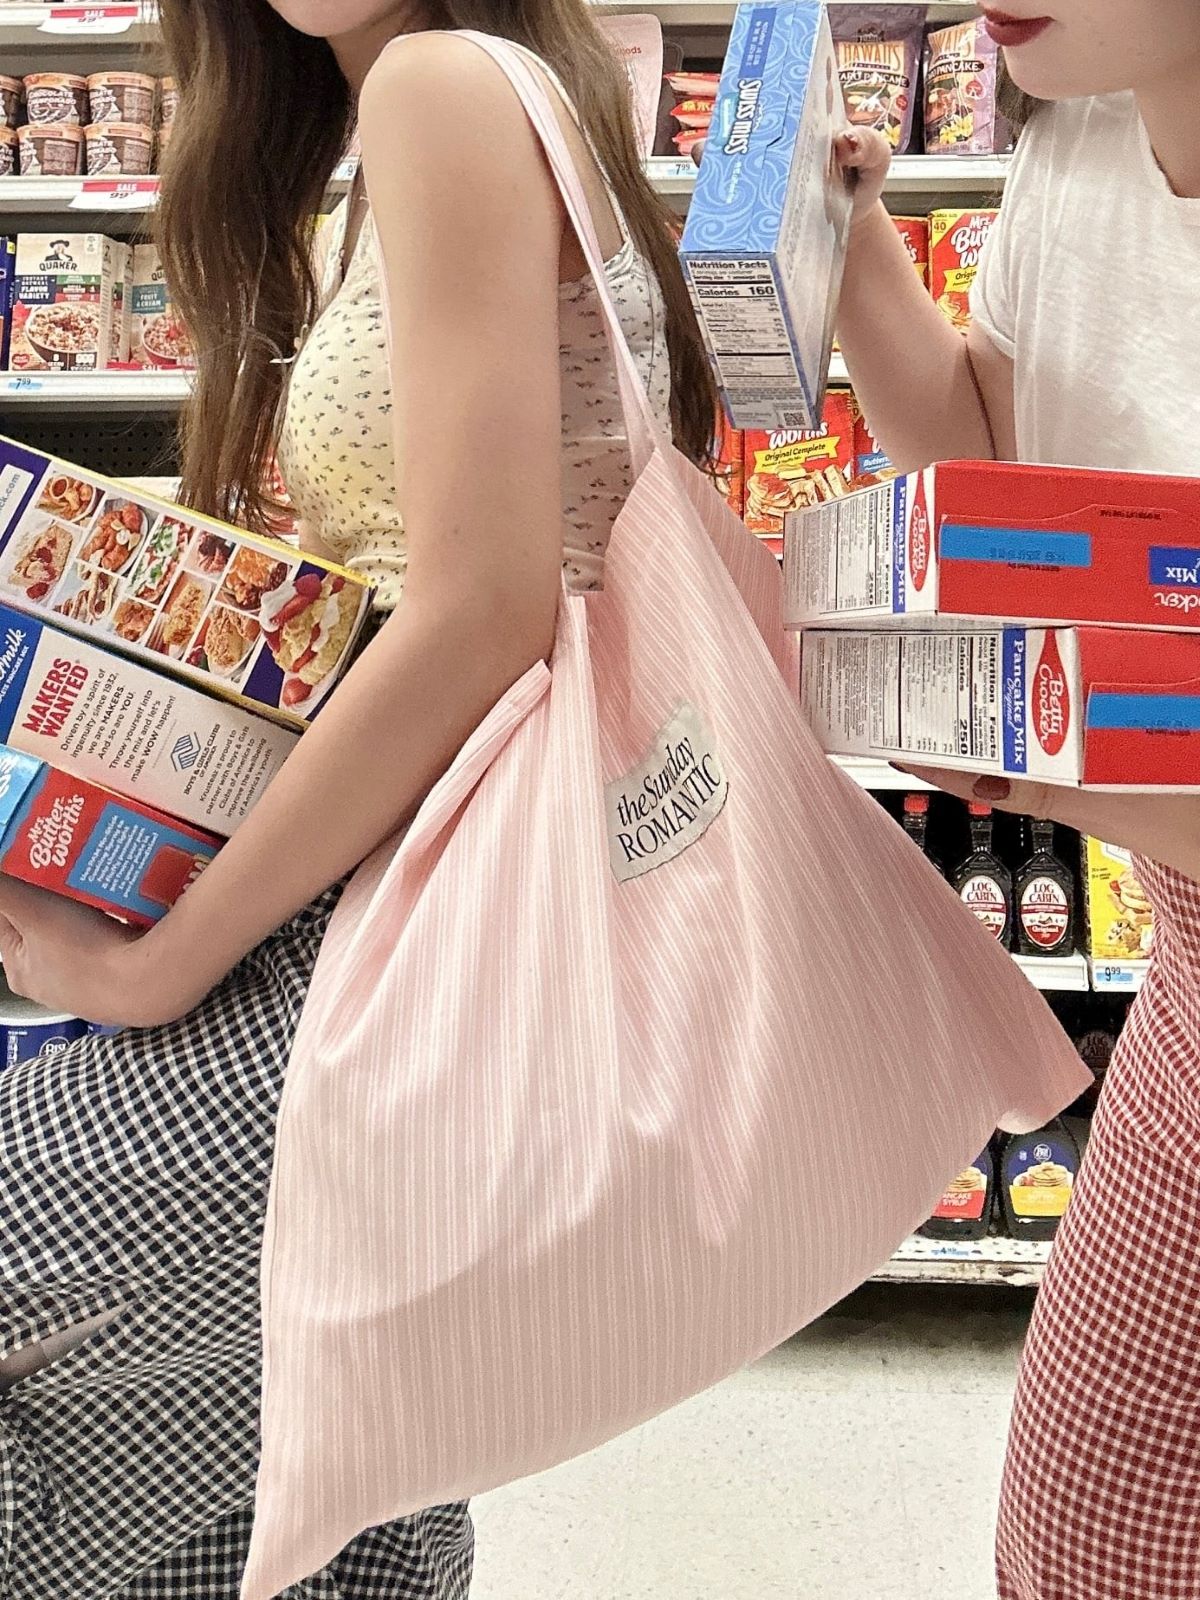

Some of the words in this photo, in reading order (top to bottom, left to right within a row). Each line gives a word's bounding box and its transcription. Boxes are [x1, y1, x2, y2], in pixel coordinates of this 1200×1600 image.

[736, 79, 763, 121] SWISS
[724, 120, 753, 156] MISS
[117, 183, 137, 191] SALE
[934, 222, 946, 230] 40
[39, 262, 78, 272] QUAKER
[690, 261, 735, 269] Nutrition
[738, 261, 767, 269] Facts
[749, 286, 774, 295] 160
[764, 449, 792, 461] Original
[793, 443, 826, 454] Complete
[898, 486, 907, 574] Pancake
[911, 504, 921, 584] Crocker
[917, 509, 927, 572] Betty
[897, 574, 906, 606] Mix
[1166, 566, 1197, 584] Mix
[1154, 592, 1200, 613] cker
[22, 658, 73, 733] MAKERS
[40, 664, 90, 738] WANTED
[1006, 677, 1017, 731] Original
[1013, 640, 1025, 723] Pancake
[1050, 672, 1064, 736] Betty
[60, 723, 79, 750] Driven
[75, 710, 86, 721] by
[86, 679, 100, 701] spirit
[98, 668, 105, 678] of
[70, 718, 95, 757] ingenuity
[92, 694, 106, 716] since
[1039, 663, 1053, 748] Crocker
[87, 741, 97, 753] we
[94, 725, 104, 739] are
[98, 740, 110, 759] And
[107, 729, 116, 739] so
[113, 714, 124, 727] are
[108, 742, 126, 768] Throw
[124, 707, 144, 740] yourself
[140, 689, 152, 706] into
[123, 754, 135, 768] the
[132, 736, 143, 752] mix
[140, 718, 151, 735] and
[147, 700, 160, 717] let's
[130, 759, 145, 782] make
[142, 730, 158, 755] WOW
[155, 695, 175, 729] happen!
[959, 719, 968, 755] 250
[1013, 727, 1025, 765] Mix
[199, 770, 218, 801] Krusteaz
[219, 738, 232, 761] proud
[229, 729, 236, 737] to
[206, 786, 221, 814] partner
[219, 769, 229, 785] with
[226, 750, 238, 768] Boys
[218, 788, 232, 808] Clubs
[229, 777, 236, 787] of
[234, 747, 250, 778] America
[247, 738, 254, 746] to
[225, 787, 243, 817] improve
[240, 773, 250, 785] the
[247, 737, 267, 772] wellbeing
[238, 807, 245, 815] of
[242, 771, 262, 806] America's
[616, 753, 721, 862] ROMANTIC
[28, 816, 46, 843] Mrs.
[30, 795, 65, 869] Butter-
[51, 794, 85, 867] worth's
[967, 891, 997, 902] CABIN
[971, 882, 992, 892] LOG
[1029, 893, 1060, 904] CABIN
[1033, 883, 1054, 893] LOG
[942, 1199, 968, 1207] SYRUP
